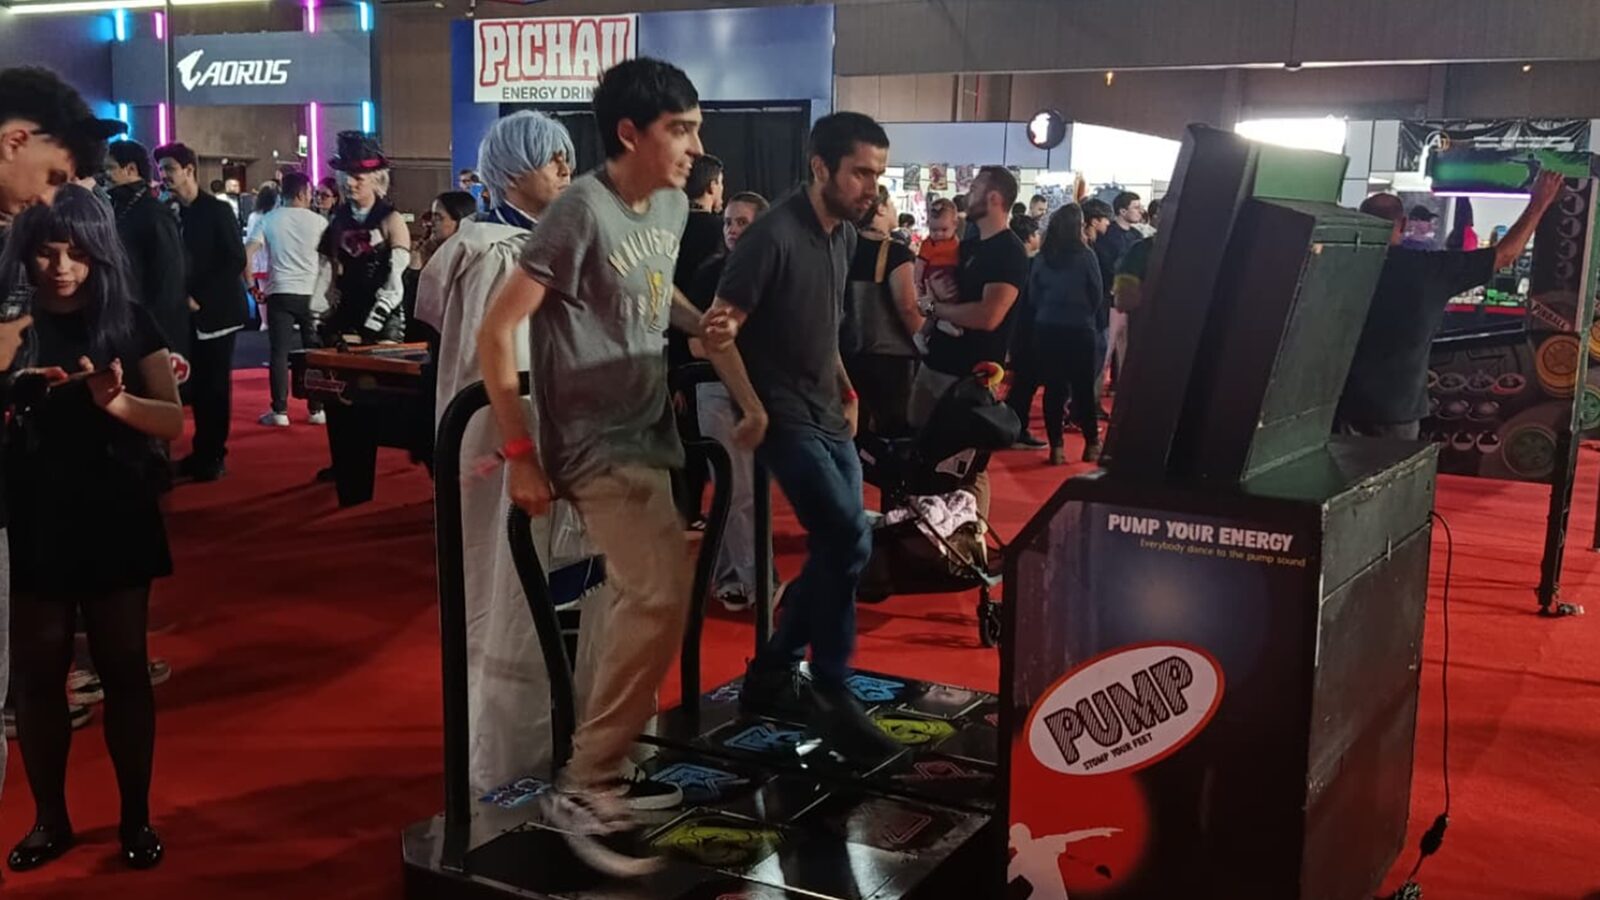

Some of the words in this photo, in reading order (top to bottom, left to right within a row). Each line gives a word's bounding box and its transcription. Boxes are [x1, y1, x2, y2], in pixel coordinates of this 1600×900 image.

[480, 18, 630, 87] PICHAU
[197, 59, 292, 86] AORUS
[502, 85, 558, 100] ENERGY
[560, 84, 595, 99] DRIN
[1108, 513, 1160, 536] PUMP
[1166, 520, 1214, 543] YOUR
[1218, 526, 1294, 551] ENERGY
[1140, 538, 1184, 554] Everybody
[1187, 546, 1214, 556] dance
[1216, 548, 1226, 557] to
[1229, 550, 1244, 559] the
[1246, 553, 1274, 564] pump
[1277, 556, 1306, 567] sound
[1043, 655, 1193, 765] PUMP
[1083, 752, 1109, 770] STOMP
[1110, 742, 1133, 757] YOUR
[1132, 732, 1153, 748] FEET
